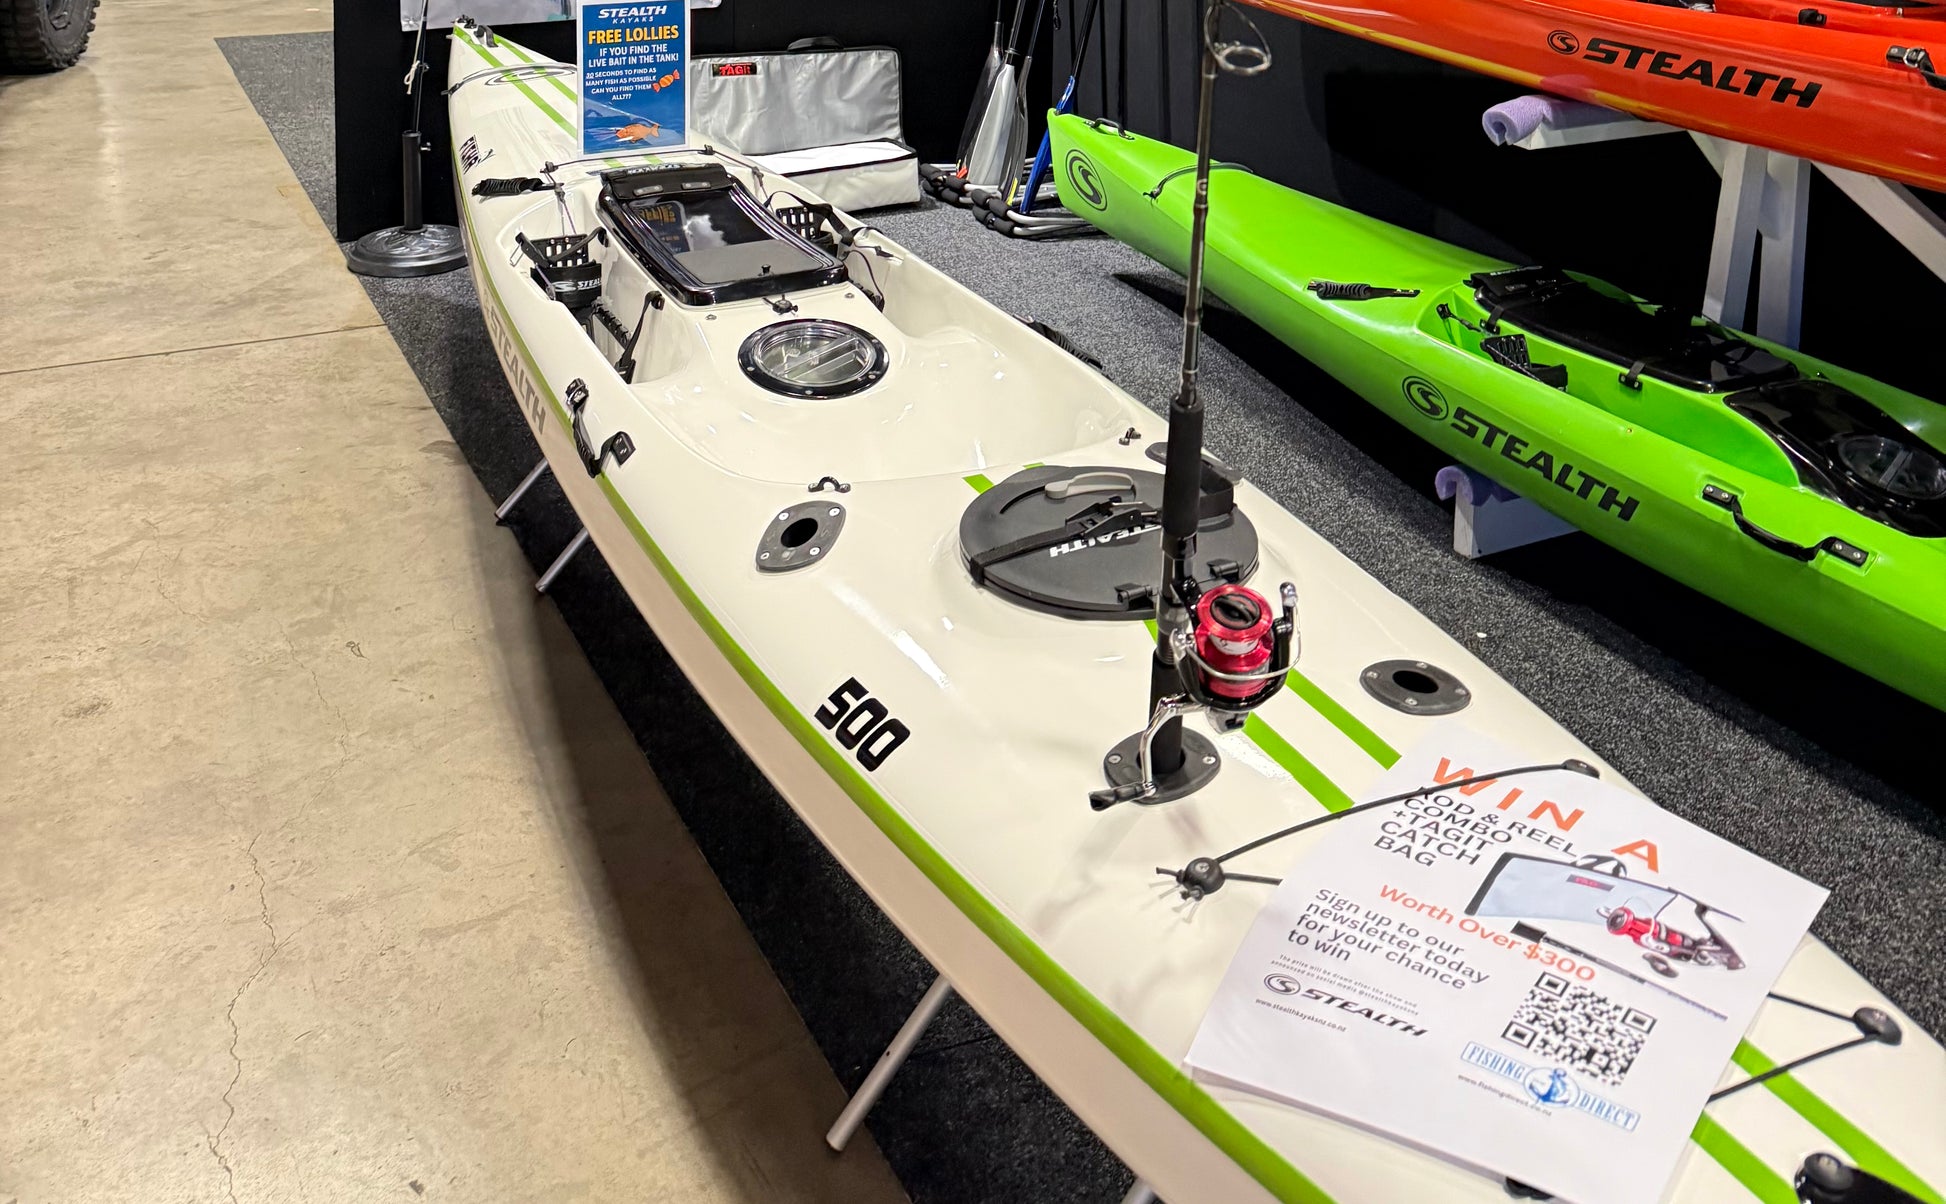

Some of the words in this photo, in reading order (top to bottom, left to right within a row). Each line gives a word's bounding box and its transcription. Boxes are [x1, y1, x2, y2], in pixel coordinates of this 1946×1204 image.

[598, 5, 667, 18] STEALTH
[612, 16, 654, 24] KAYAKS
[588, 29, 622, 44] FREE
[625, 25, 679, 42] LOLLIES
[600, 48, 608, 57] IF
[609, 47, 628, 57] YOU
[629, 45, 650, 55] FIND
[651, 44, 668, 53] THE
[588, 58, 607, 68] LIVE
[608, 57, 627, 67] BAIT
[628, 56, 638, 65] IN
[639, 55, 655, 63] THE
[656, 53, 679, 62] TANK!
[595, 69, 623, 78] SECONDS
[633, 67, 648, 75] FIND
[628, 75, 657, 83] POSSIBLE
[1582, 37, 1823, 109] STEALTH
[605, 85, 619, 93] YOU
[635, 83, 652, 91] THEM
[490, 305, 546, 435] STEALTH
[1451, 406, 1640, 522] STEALTH
[814, 676, 911, 772] 500
[1393, 810, 1495, 851] +TAGIT
[1403, 798, 1512, 844] COMBO
[1432, 757, 1585, 832] WIN
[1610, 839, 1659, 873] A
[1481, 811, 1500, 826] &
[1507, 821, 1578, 858] REEL
[1374, 835, 1437, 867] BAG
[1380, 821, 1481, 866] CATCH
[1306, 903, 1421, 954] newsletter
[1424, 948, 1490, 984] today
[1315, 888, 1361, 914] Sign
[1364, 910, 1392, 927] up
[1398, 922, 1420, 938] to
[1425, 935, 1465, 955] our
[1380, 884, 1454, 924] Worth
[1458, 918, 1522, 951] Over
[1523, 940, 1596, 983] $300
[1279, 953, 1291, 962] The
[1309, 964, 1322, 973] will
[1288, 929, 1309, 946] to
[1314, 939, 1351, 961] win
[1296, 913, 1330, 934] for
[1327, 928, 1383, 954] your
[1385, 951, 1466, 990] chance
[1300, 987, 1428, 1037] STEALTH
[1467, 1045, 1526, 1080] FISHING
[1579, 1092, 1636, 1128] DIRECT
